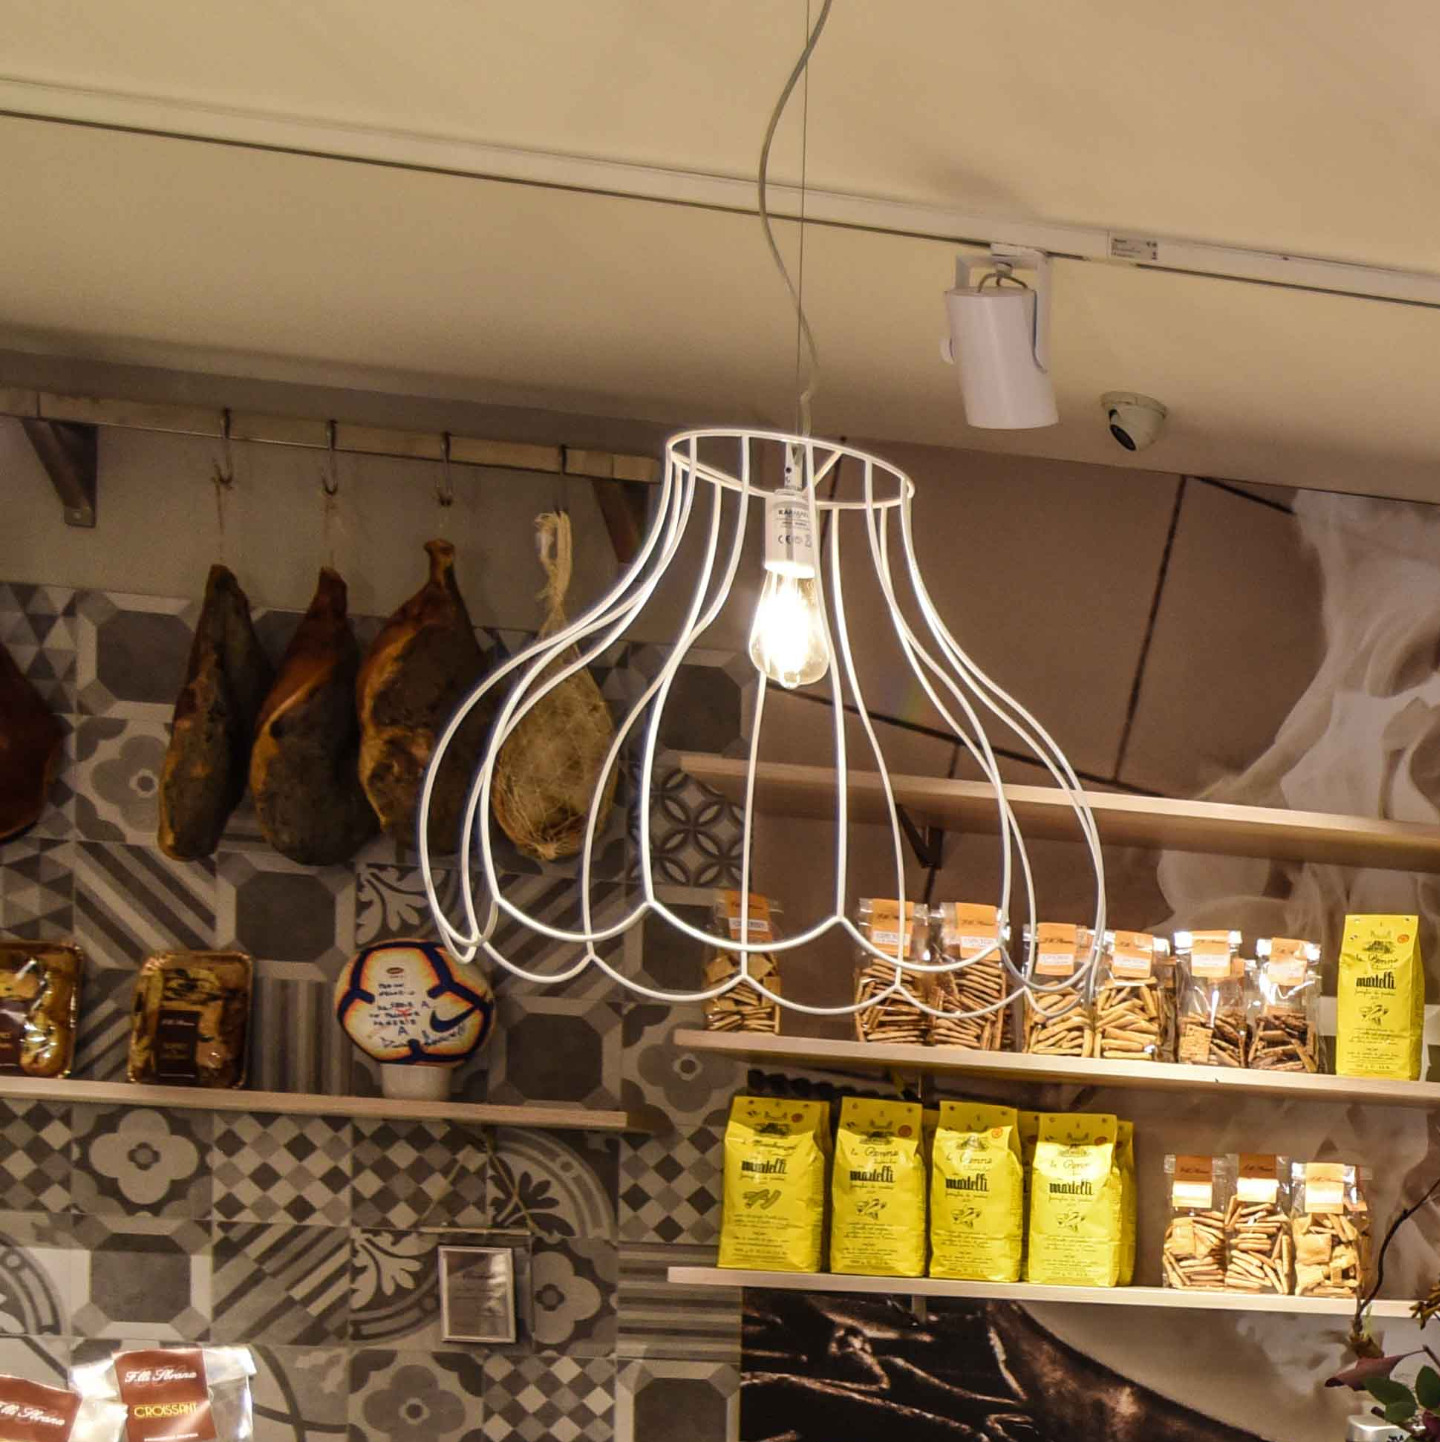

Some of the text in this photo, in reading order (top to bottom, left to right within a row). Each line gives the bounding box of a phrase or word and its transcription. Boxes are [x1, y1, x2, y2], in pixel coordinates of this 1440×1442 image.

[1355, 971, 1397, 989] martelli
[741, 1157, 788, 1175] martelli
[849, 1165, 897, 1183] martelli
[945, 1173, 990, 1192] martelli
[1048, 1178, 1095, 1196] martelli
[152, 1369, 197, 1382] Sbrana
[134, 1402, 198, 1419] CROISSANT
